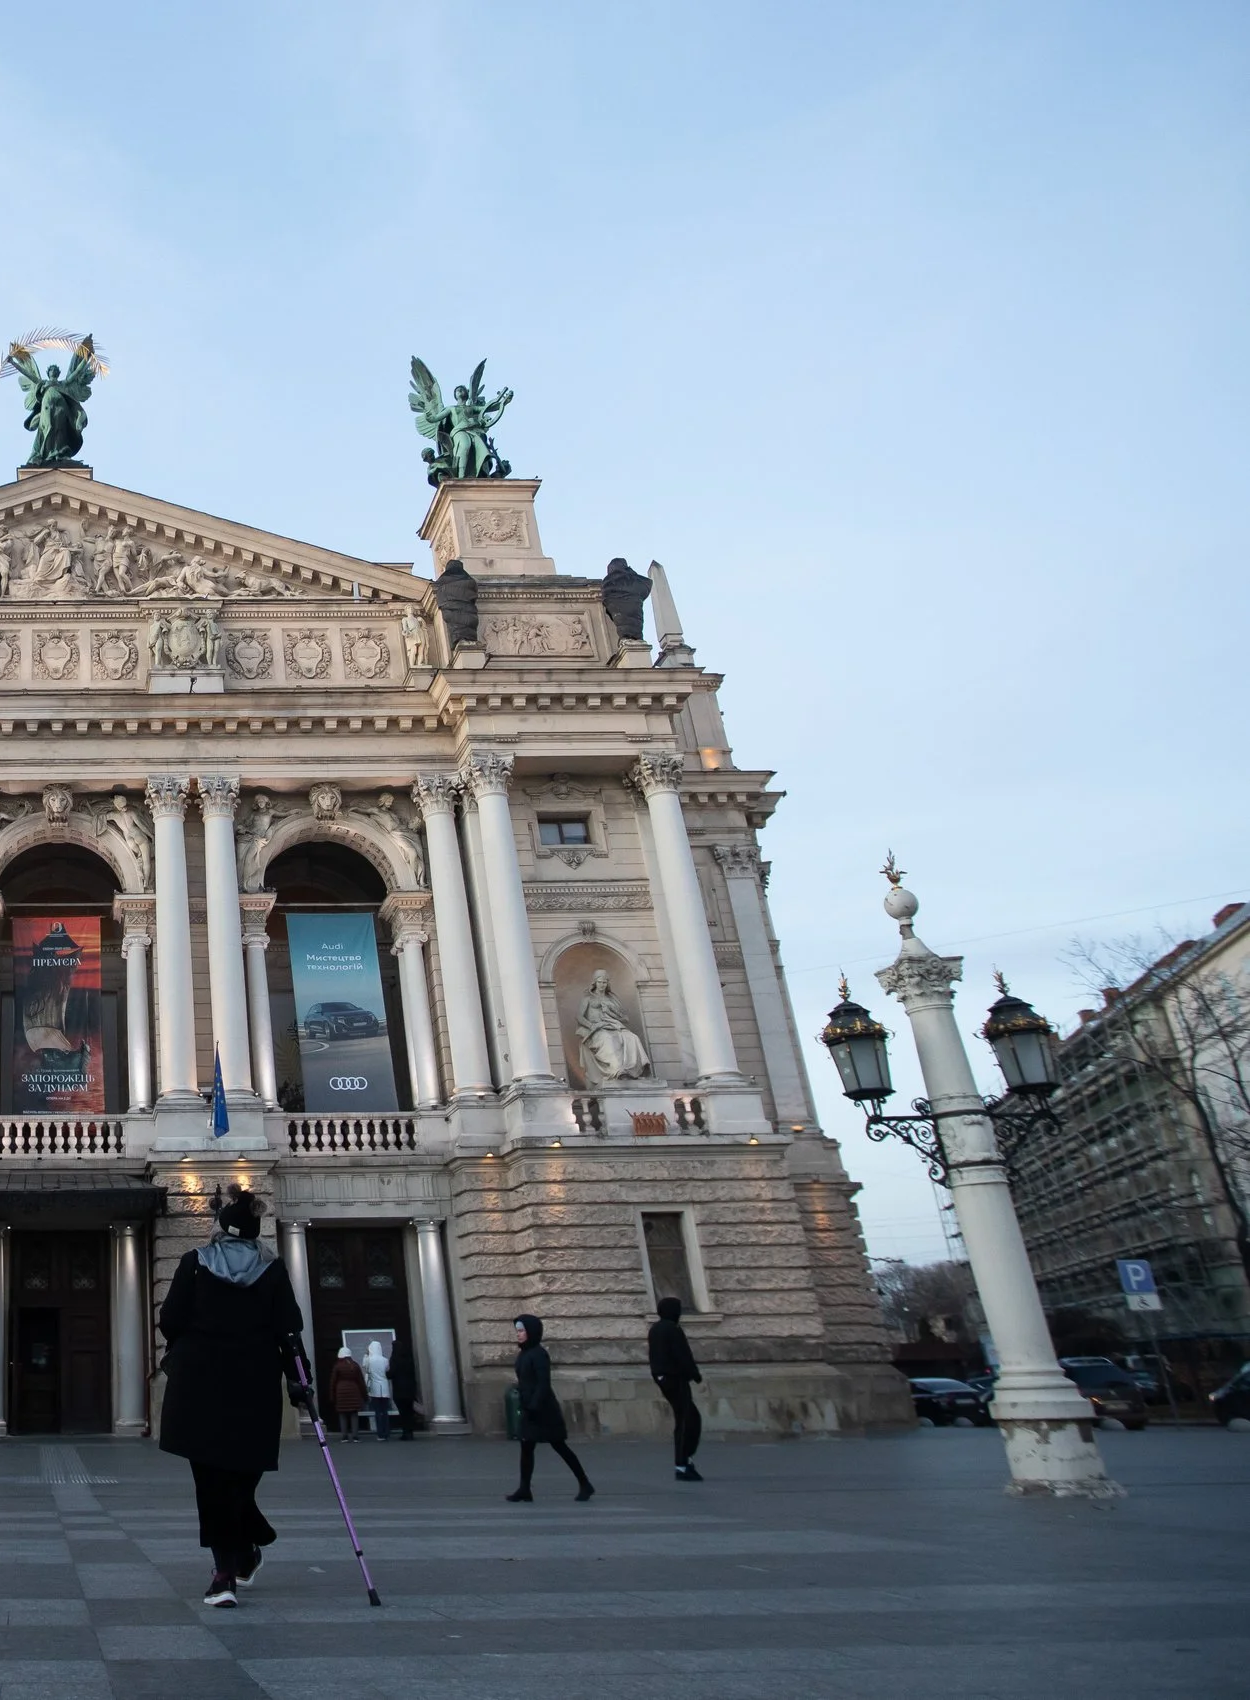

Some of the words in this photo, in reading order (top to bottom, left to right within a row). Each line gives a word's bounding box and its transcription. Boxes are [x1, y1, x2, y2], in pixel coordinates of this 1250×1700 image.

[306, 954, 362, 962] Мистецтво
[21, 1074, 95, 1083] ЗАПОРОЖЕЦЬ
[28, 1084, 42, 1092] ЗА
[43, 1084, 88, 1093] ДУНАЄМ
[1126, 1264, 1146, 1290] P
